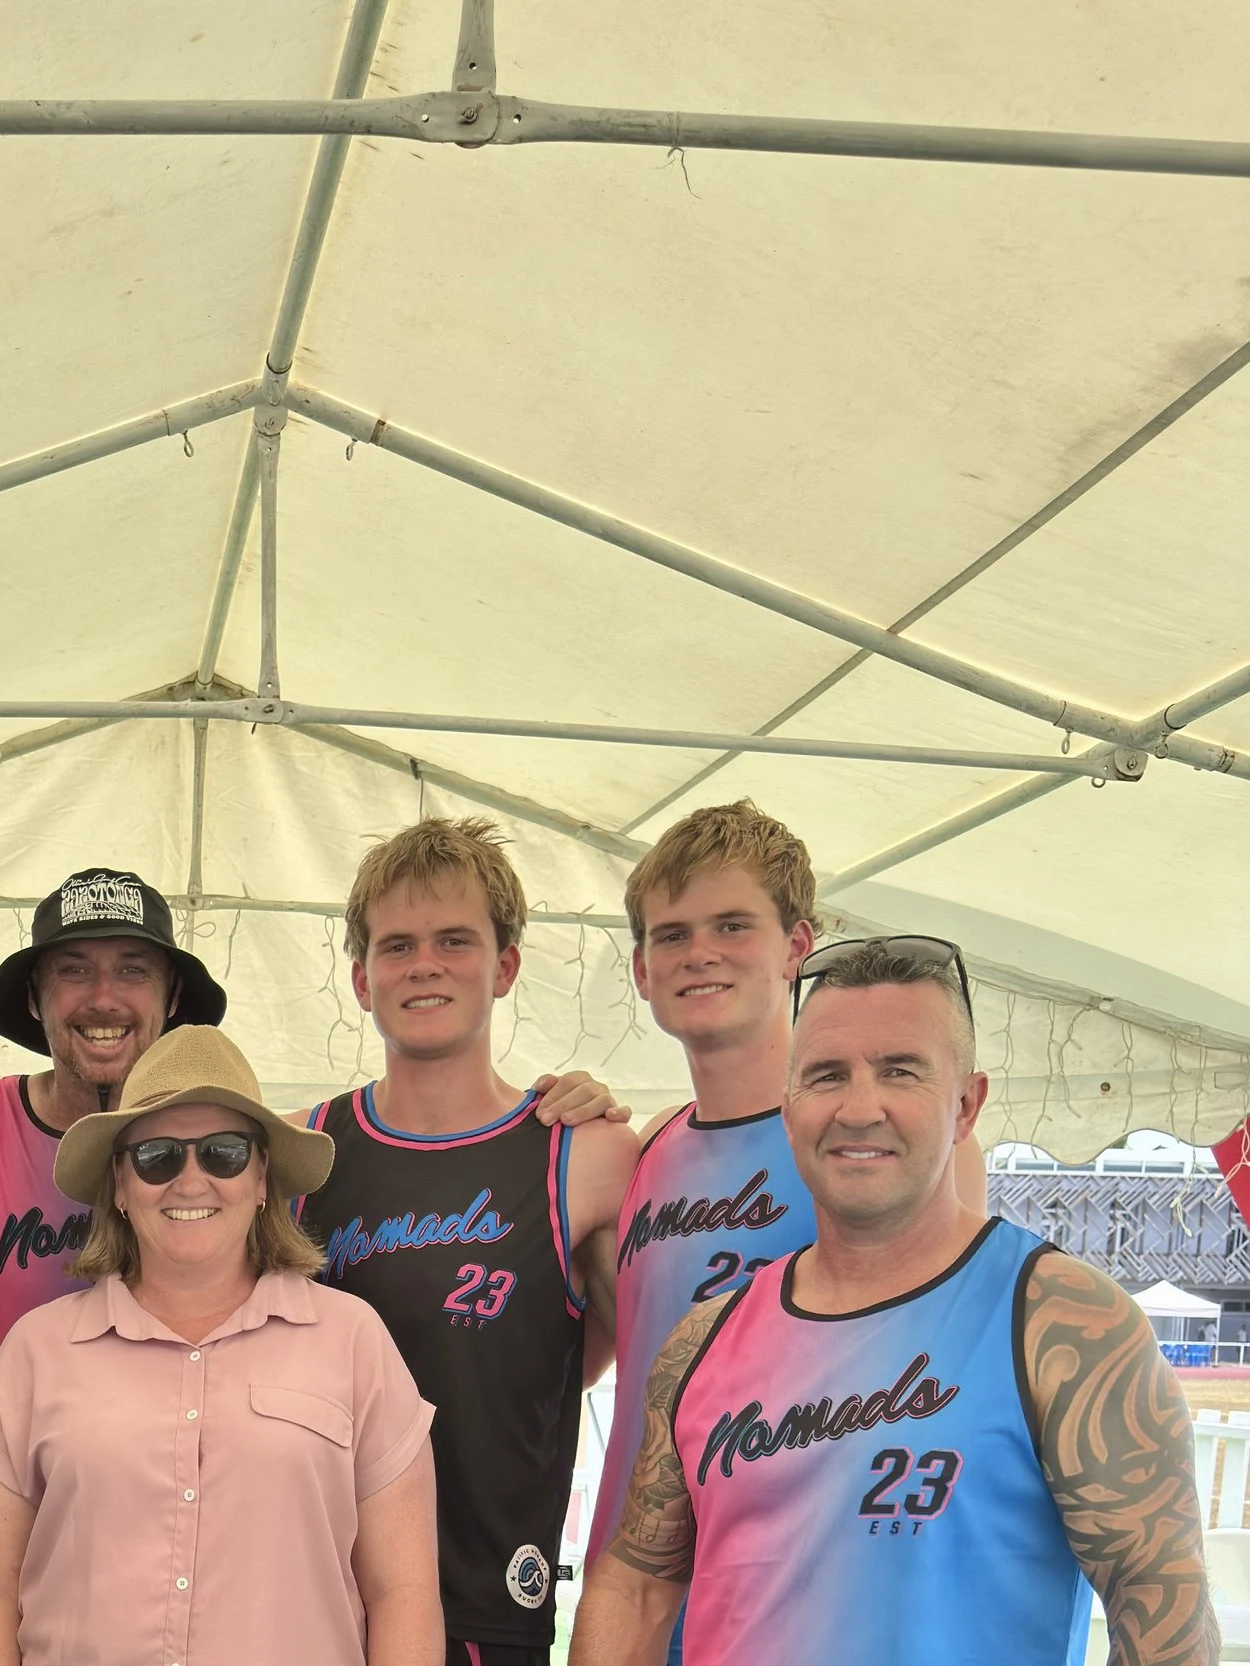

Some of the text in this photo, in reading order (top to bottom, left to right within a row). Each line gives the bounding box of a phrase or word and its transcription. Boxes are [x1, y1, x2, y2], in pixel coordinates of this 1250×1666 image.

[322, 1187, 514, 1286] Nomads
[617, 1168, 789, 1275] Nomads
[442, 1262, 518, 1320] 23
[449, 1314, 489, 1331] EST
[696, 1352, 960, 1486] Nomads
[857, 1446, 965, 1520] 23
[868, 1520, 923, 1537] EST
